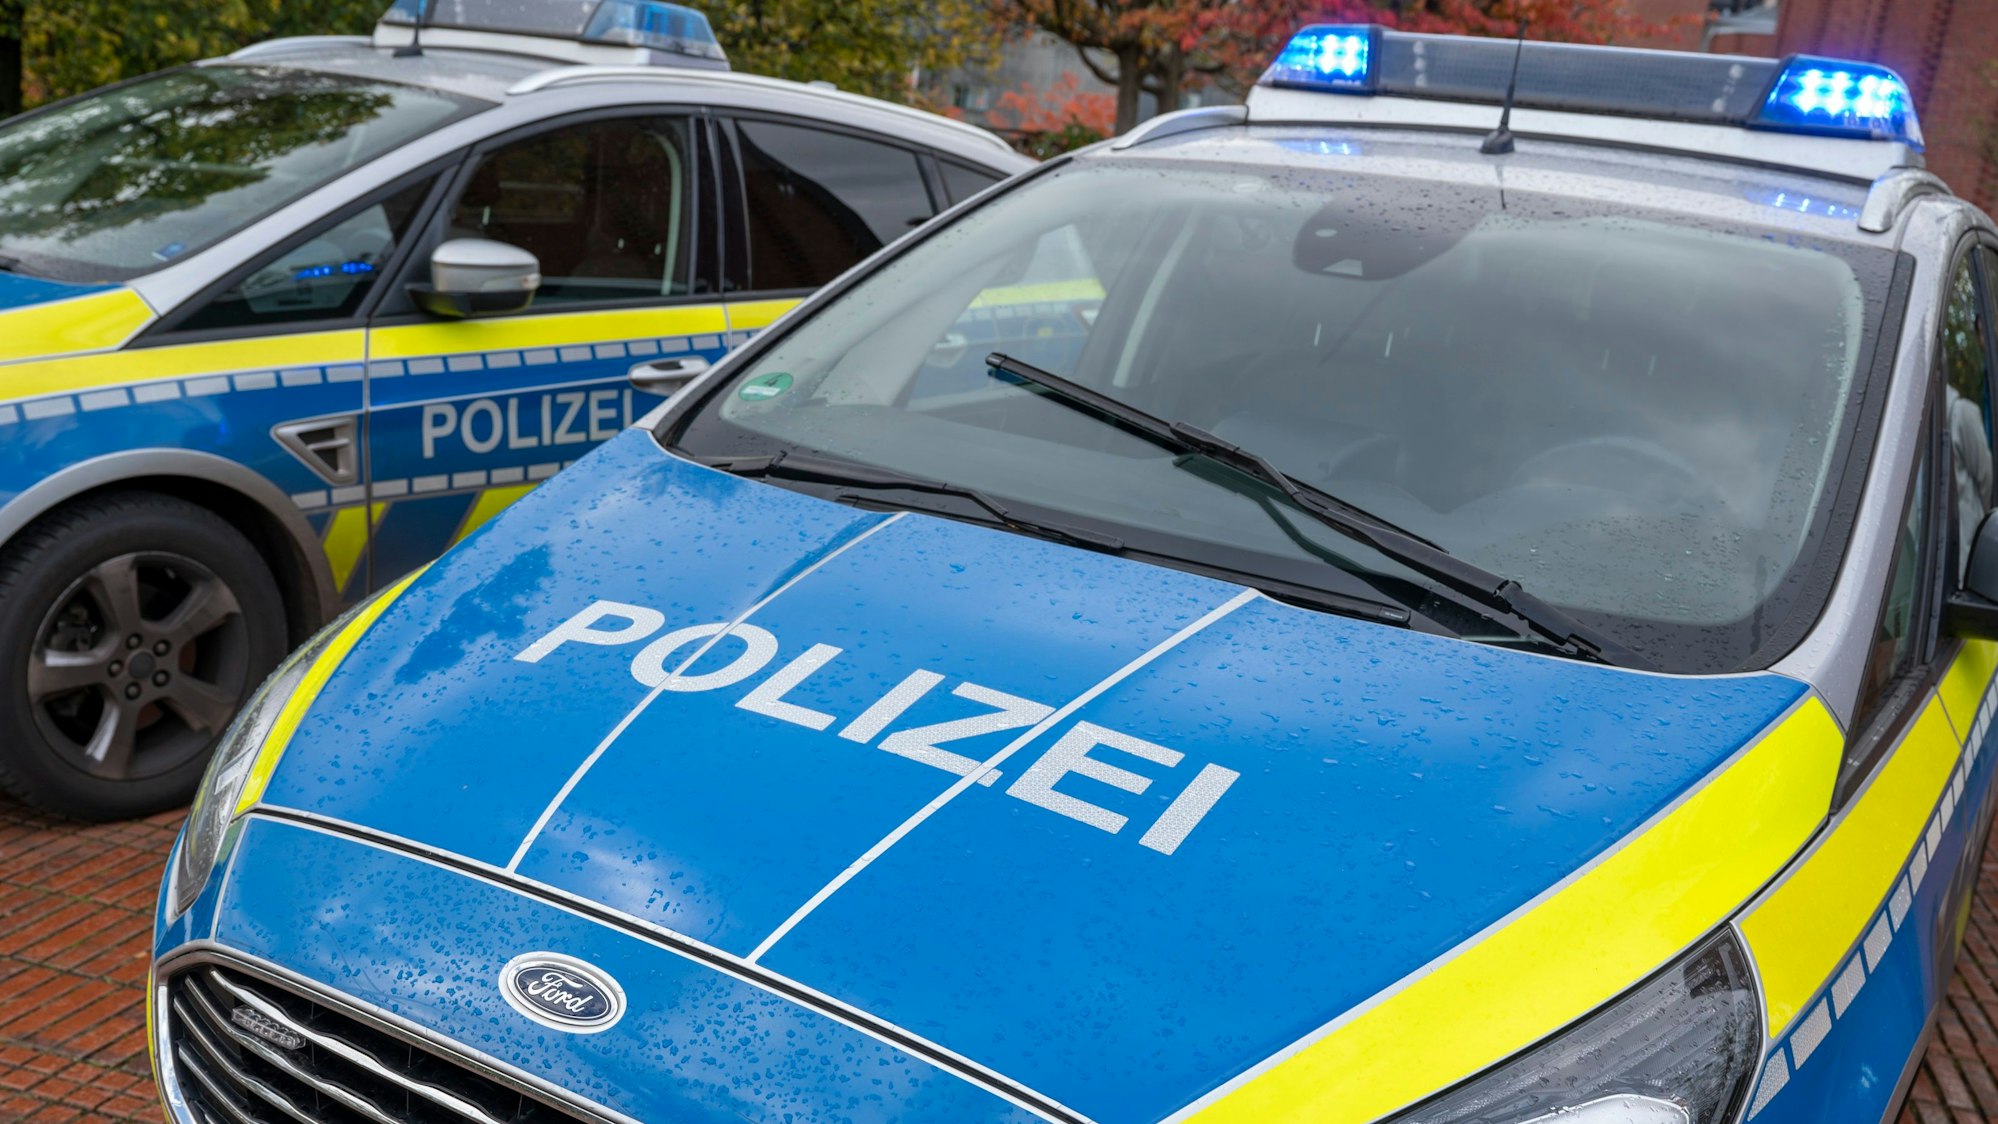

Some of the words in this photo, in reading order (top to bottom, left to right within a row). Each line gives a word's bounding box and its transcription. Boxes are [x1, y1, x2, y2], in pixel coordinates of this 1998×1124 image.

[422, 388, 632, 459] POLIZEI
[513, 600, 1240, 855] POLIZEI
[527, 972, 594, 1013] Ford
